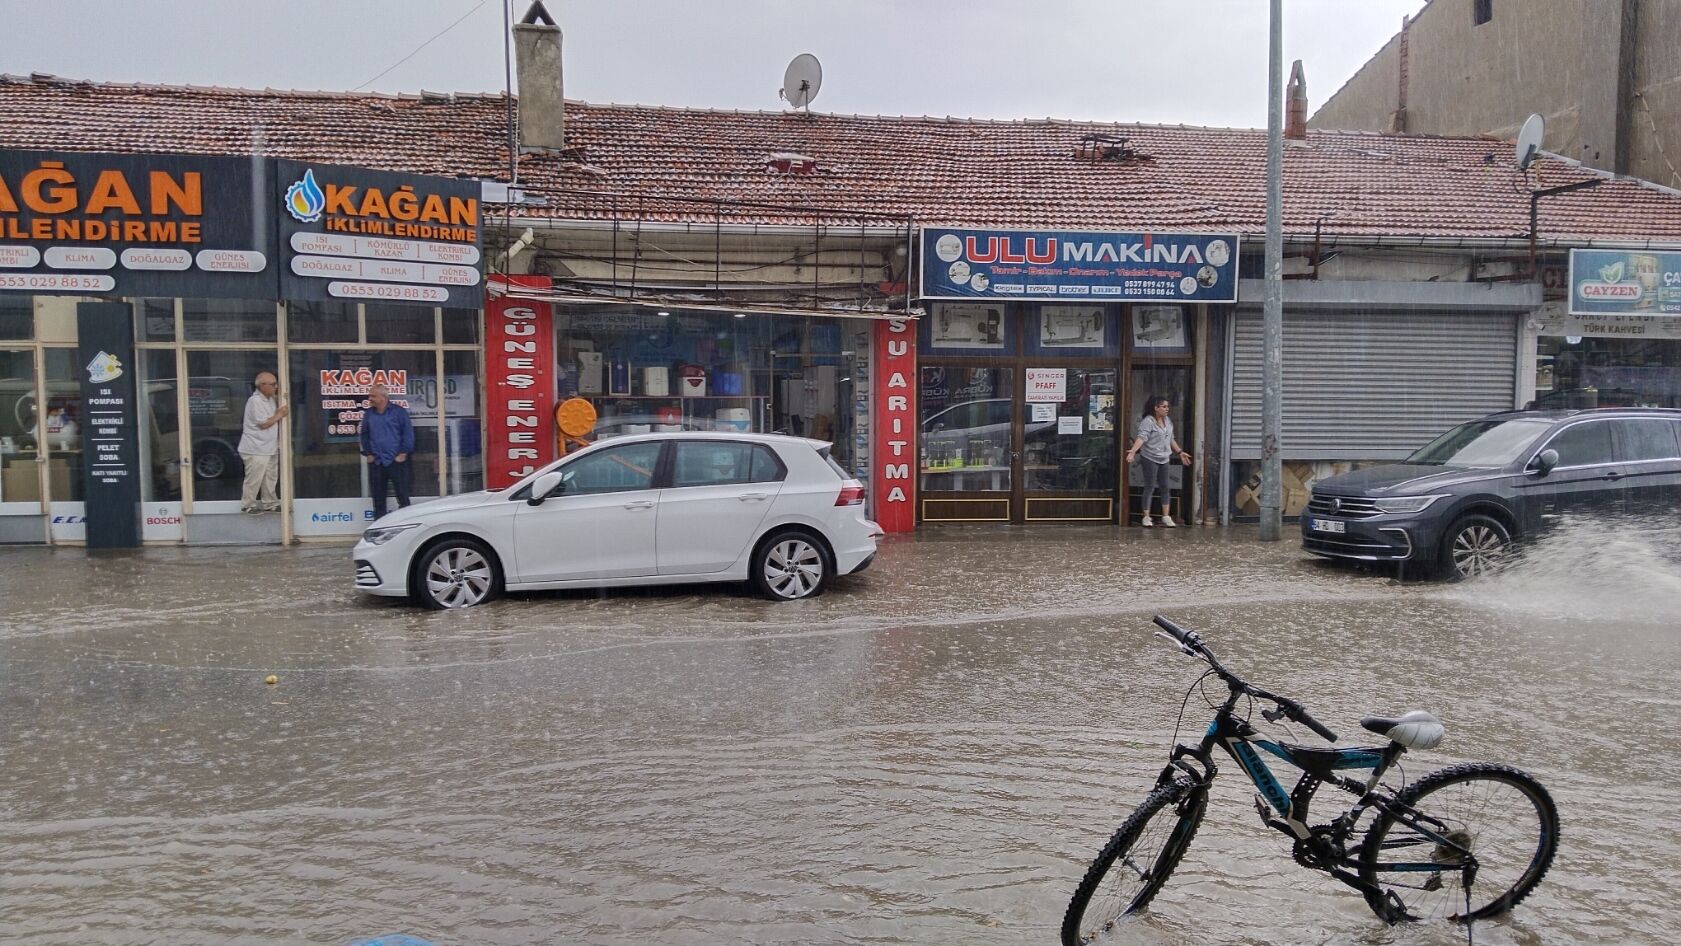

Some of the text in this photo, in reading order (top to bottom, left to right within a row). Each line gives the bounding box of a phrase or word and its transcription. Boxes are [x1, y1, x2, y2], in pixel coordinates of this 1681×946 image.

[325, 184, 477, 226] KAĞAN
[0, 218, 201, 242] LENDİRME
[327, 217, 477, 242] İKLİMLENDİRME
[966, 233, 1203, 264] ULU MAKİNA
[130, 254, 184, 264] DOĞALGAZ
[302, 261, 352, 271] DOĞALGAZ
[990, 265, 1022, 275] Tamir
[30, 277, 56, 287] 029
[61, 277, 78, 288] 88
[83, 279, 100, 288] 52
[342, 285, 437, 299] 0553 029 88 52
[1583, 285, 1638, 297] ÇAYZEN
[1583, 322, 1645, 334] TÜRK KAHVESİ
[503, 307, 537, 389] GÜNEŞ
[321, 367, 406, 387] KAĞAN
[885, 319, 909, 502] SU ARITMA
[146, 517, 181, 525] BOSCH
[320, 512, 353, 522] airfel
